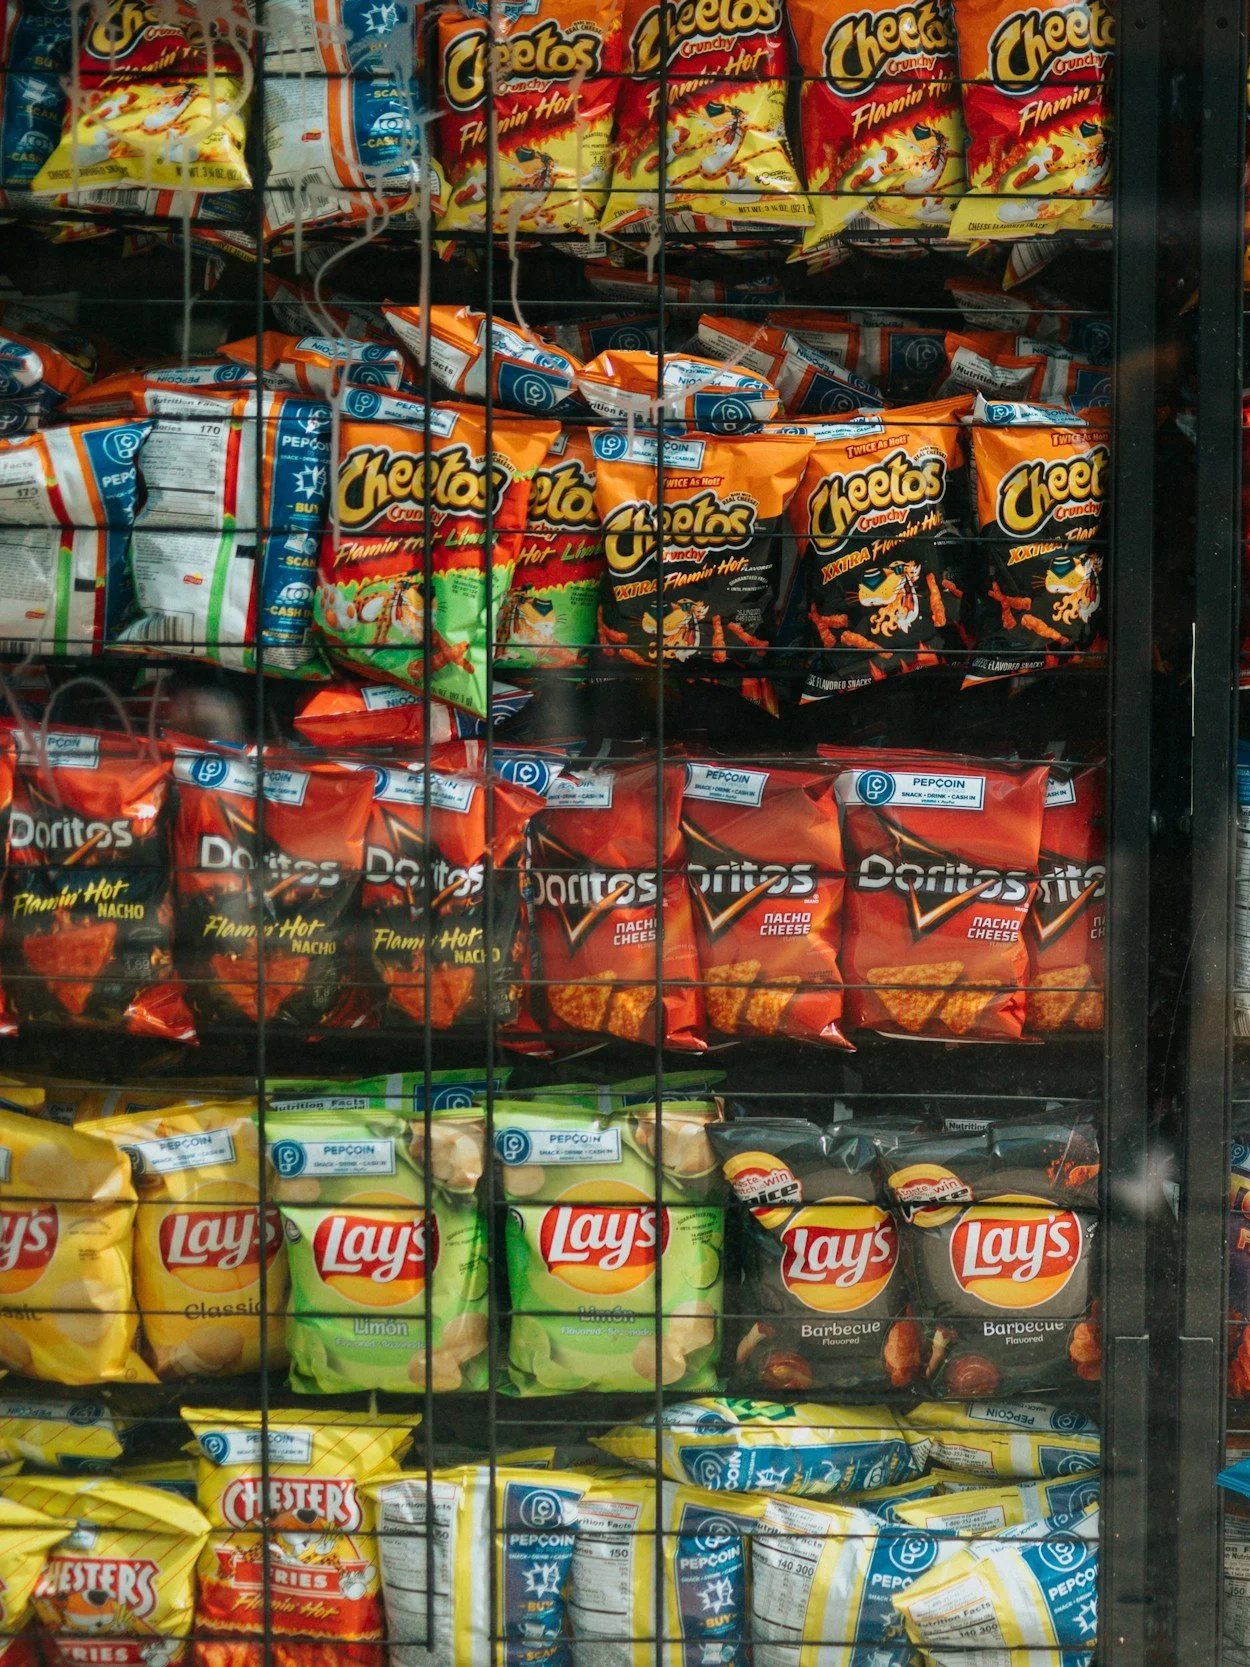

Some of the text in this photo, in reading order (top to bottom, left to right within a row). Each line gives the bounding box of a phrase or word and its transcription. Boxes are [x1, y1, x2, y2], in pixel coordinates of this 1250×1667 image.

[681, 35, 735, 57] Crunchy
[828, 2, 957, 88] Cheeto
[449, 25, 595, 104] Ceetos
[724, 46, 769, 75] Hot
[887, 57, 935, 75] Crunchy
[1053, 56, 1102, 73] Crunchy
[536, 93, 583, 116] Hot
[853, 86, 922, 137] Flamin'
[1020, 86, 1095, 135] Flamin'
[201, 424, 221, 435] 170
[847, 435, 907, 459] TWICE Hot!
[295, 503, 318, 513] BUY
[813, 457, 943, 551] Cheetos
[1055, 501, 1101, 520] Crunchy
[858, 509, 907, 531] Crunchy
[335, 541, 402, 565] Flamin'
[664, 564, 717, 590] Flamin'
[718, 558, 747, 575] Hot
[823, 551, 869, 583] XXTRA
[270, 607, 304, 617] CASH
[816, 677, 846, 691] FLAVORED
[11, 813, 132, 848] Doritos
[201, 835, 340, 885] Doitos
[366, 846, 483, 897] Doitos
[860, 855, 1028, 901] Doritos
[13, 876, 128, 918] Flamin' Hot
[98, 903, 144, 919] NACHO
[764, 914, 810, 924] NACHO
[281, 916, 325, 937] Hot
[761, 923, 810, 935] CHEESE
[973, 917, 1019, 930] NACHO
[441, 929, 482, 948] Hot
[968, 928, 1018, 941] CHEESE
[292, 940, 336, 954] NACHO
[549, 1205, 656, 1270] Lay's
[322, 1215, 428, 1282] Lay's
[788, 1224, 891, 1287] Lay's
[963, 1216, 1071, 1282] Lay's
[355, 1317, 407, 1336] Limón
[802, 1322, 880, 1338] Barbecue
[984, 1321, 1064, 1337] Barbecue
[822, 1337, 860, 1346] Flavored
[1006, 1336, 1043, 1345] Flavored
[610, 1549, 628, 1558] 150
[777, 1559, 814, 1577] 140 300
[705, 1614, 732, 1628] BUY
